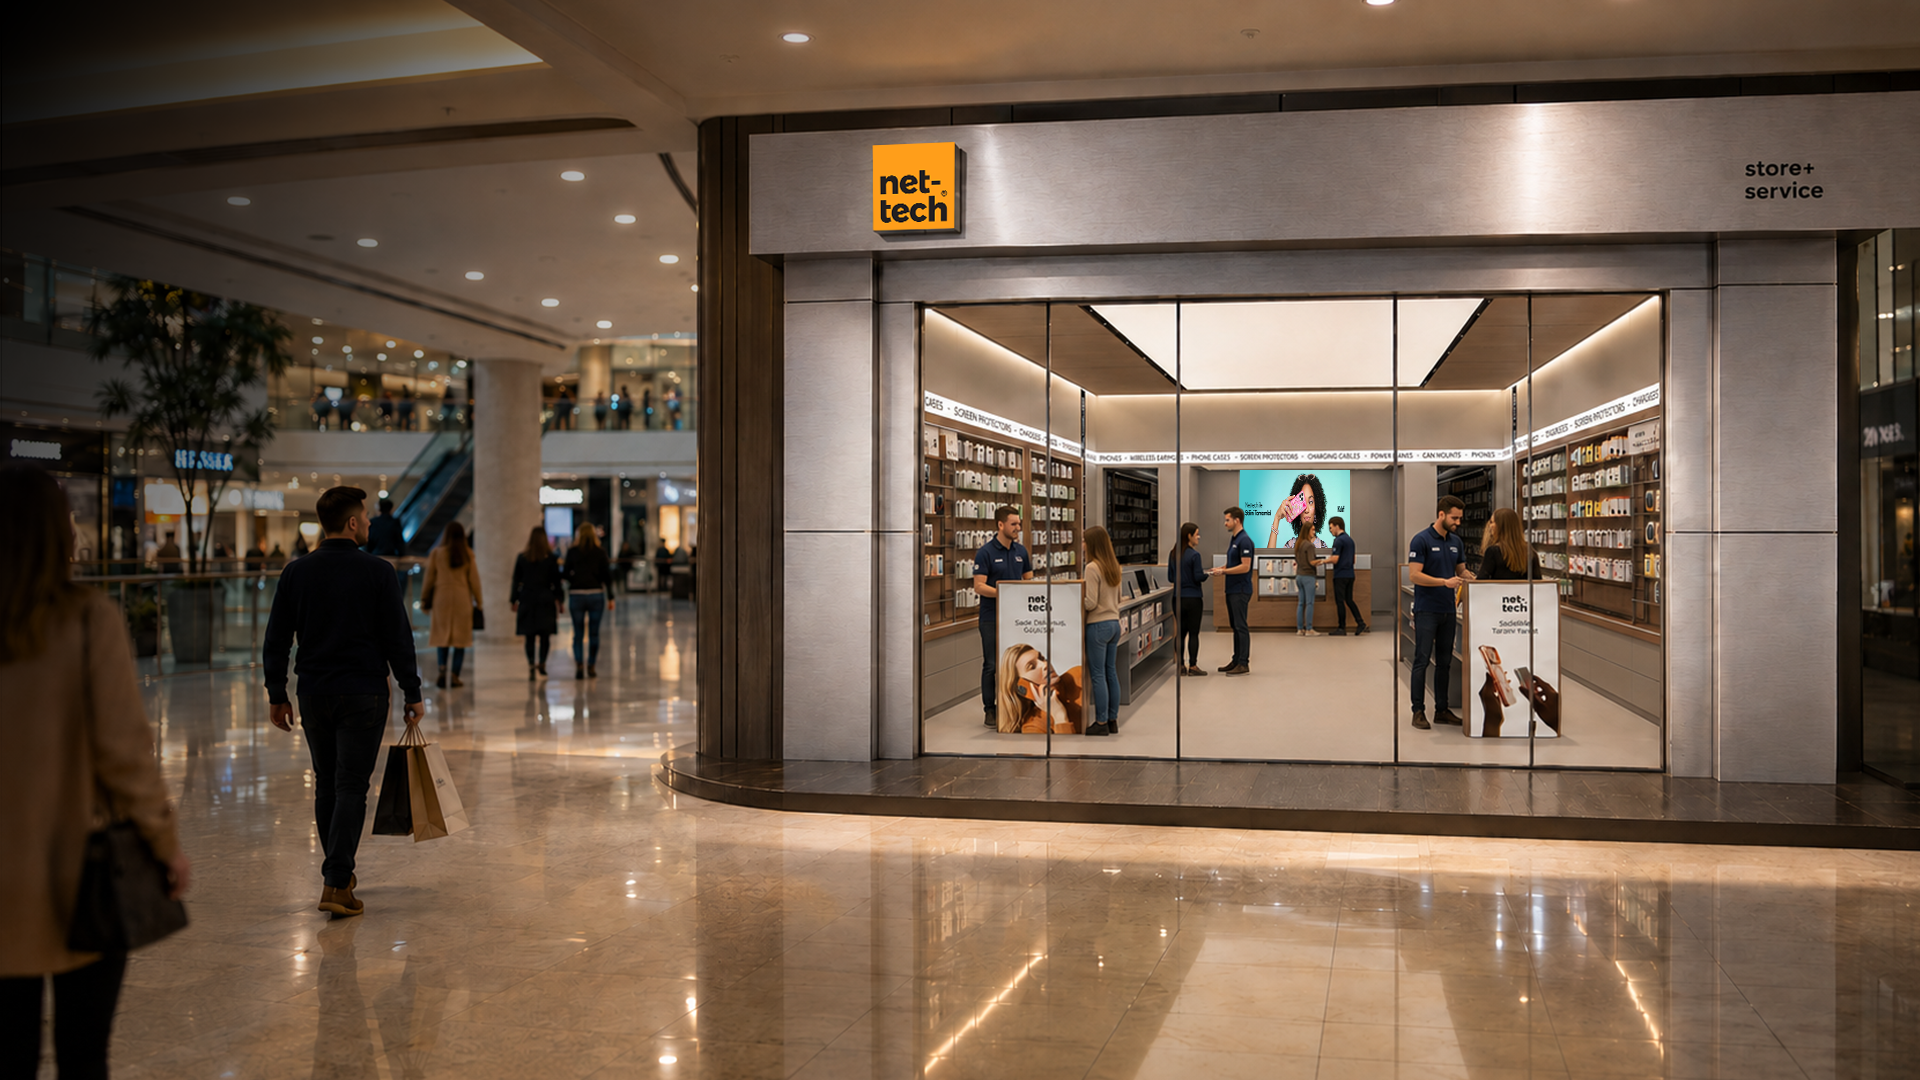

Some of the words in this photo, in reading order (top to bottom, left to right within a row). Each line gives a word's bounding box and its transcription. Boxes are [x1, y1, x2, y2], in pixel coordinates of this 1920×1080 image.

[1745, 161, 1815, 177] store+
[880, 170, 941, 194] net-
[1745, 181, 1824, 199] service
[880, 195, 948, 223] tech
[1502, 603, 1527, 612] tech
